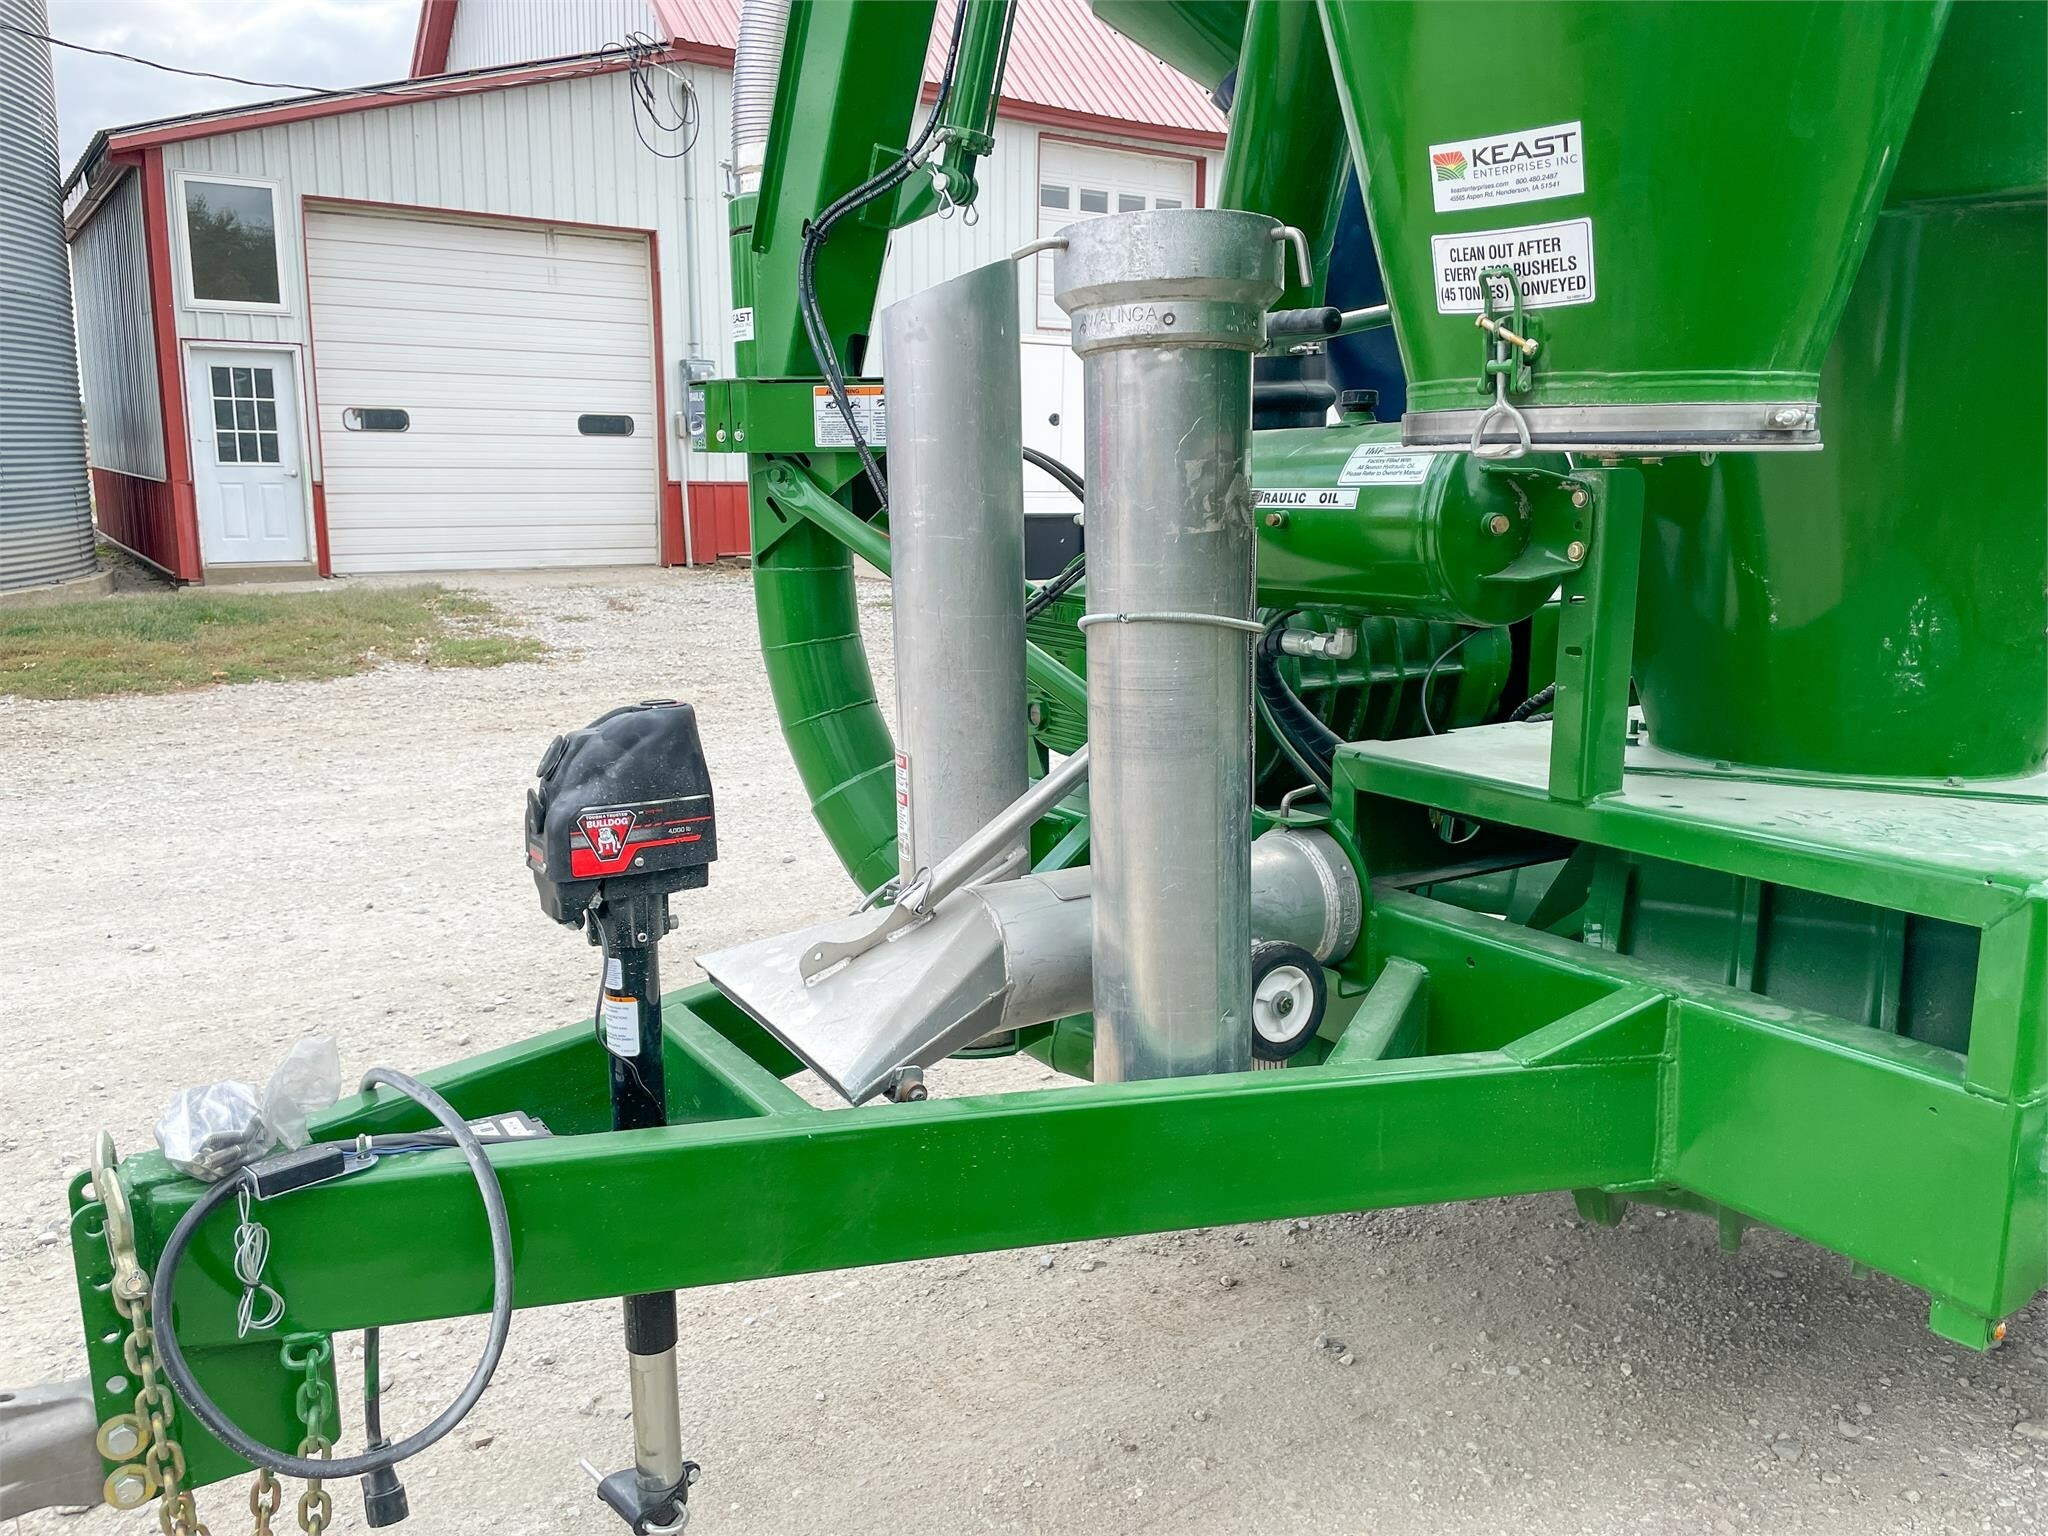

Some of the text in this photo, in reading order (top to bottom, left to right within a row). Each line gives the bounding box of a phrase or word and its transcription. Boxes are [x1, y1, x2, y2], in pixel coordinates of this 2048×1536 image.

[1472, 132, 1576, 167] KEAST
[1473, 154, 1578, 179] ENTERPRISES INC
[1466, 191, 1484, 201] Aspen
[1540, 181, 1560, 191] 51541
[1450, 237, 1561, 263] CLEAN OUT AFTER
[1444, 266, 1477, 282] EVERY
[1513, 255, 1577, 277] BUSHELS
[1441, 275, 1586, 304] (45 TONES) ONVEYED
[1319, 492, 1339, 504] OIL
[586, 817, 628, 829] BULLDOG
